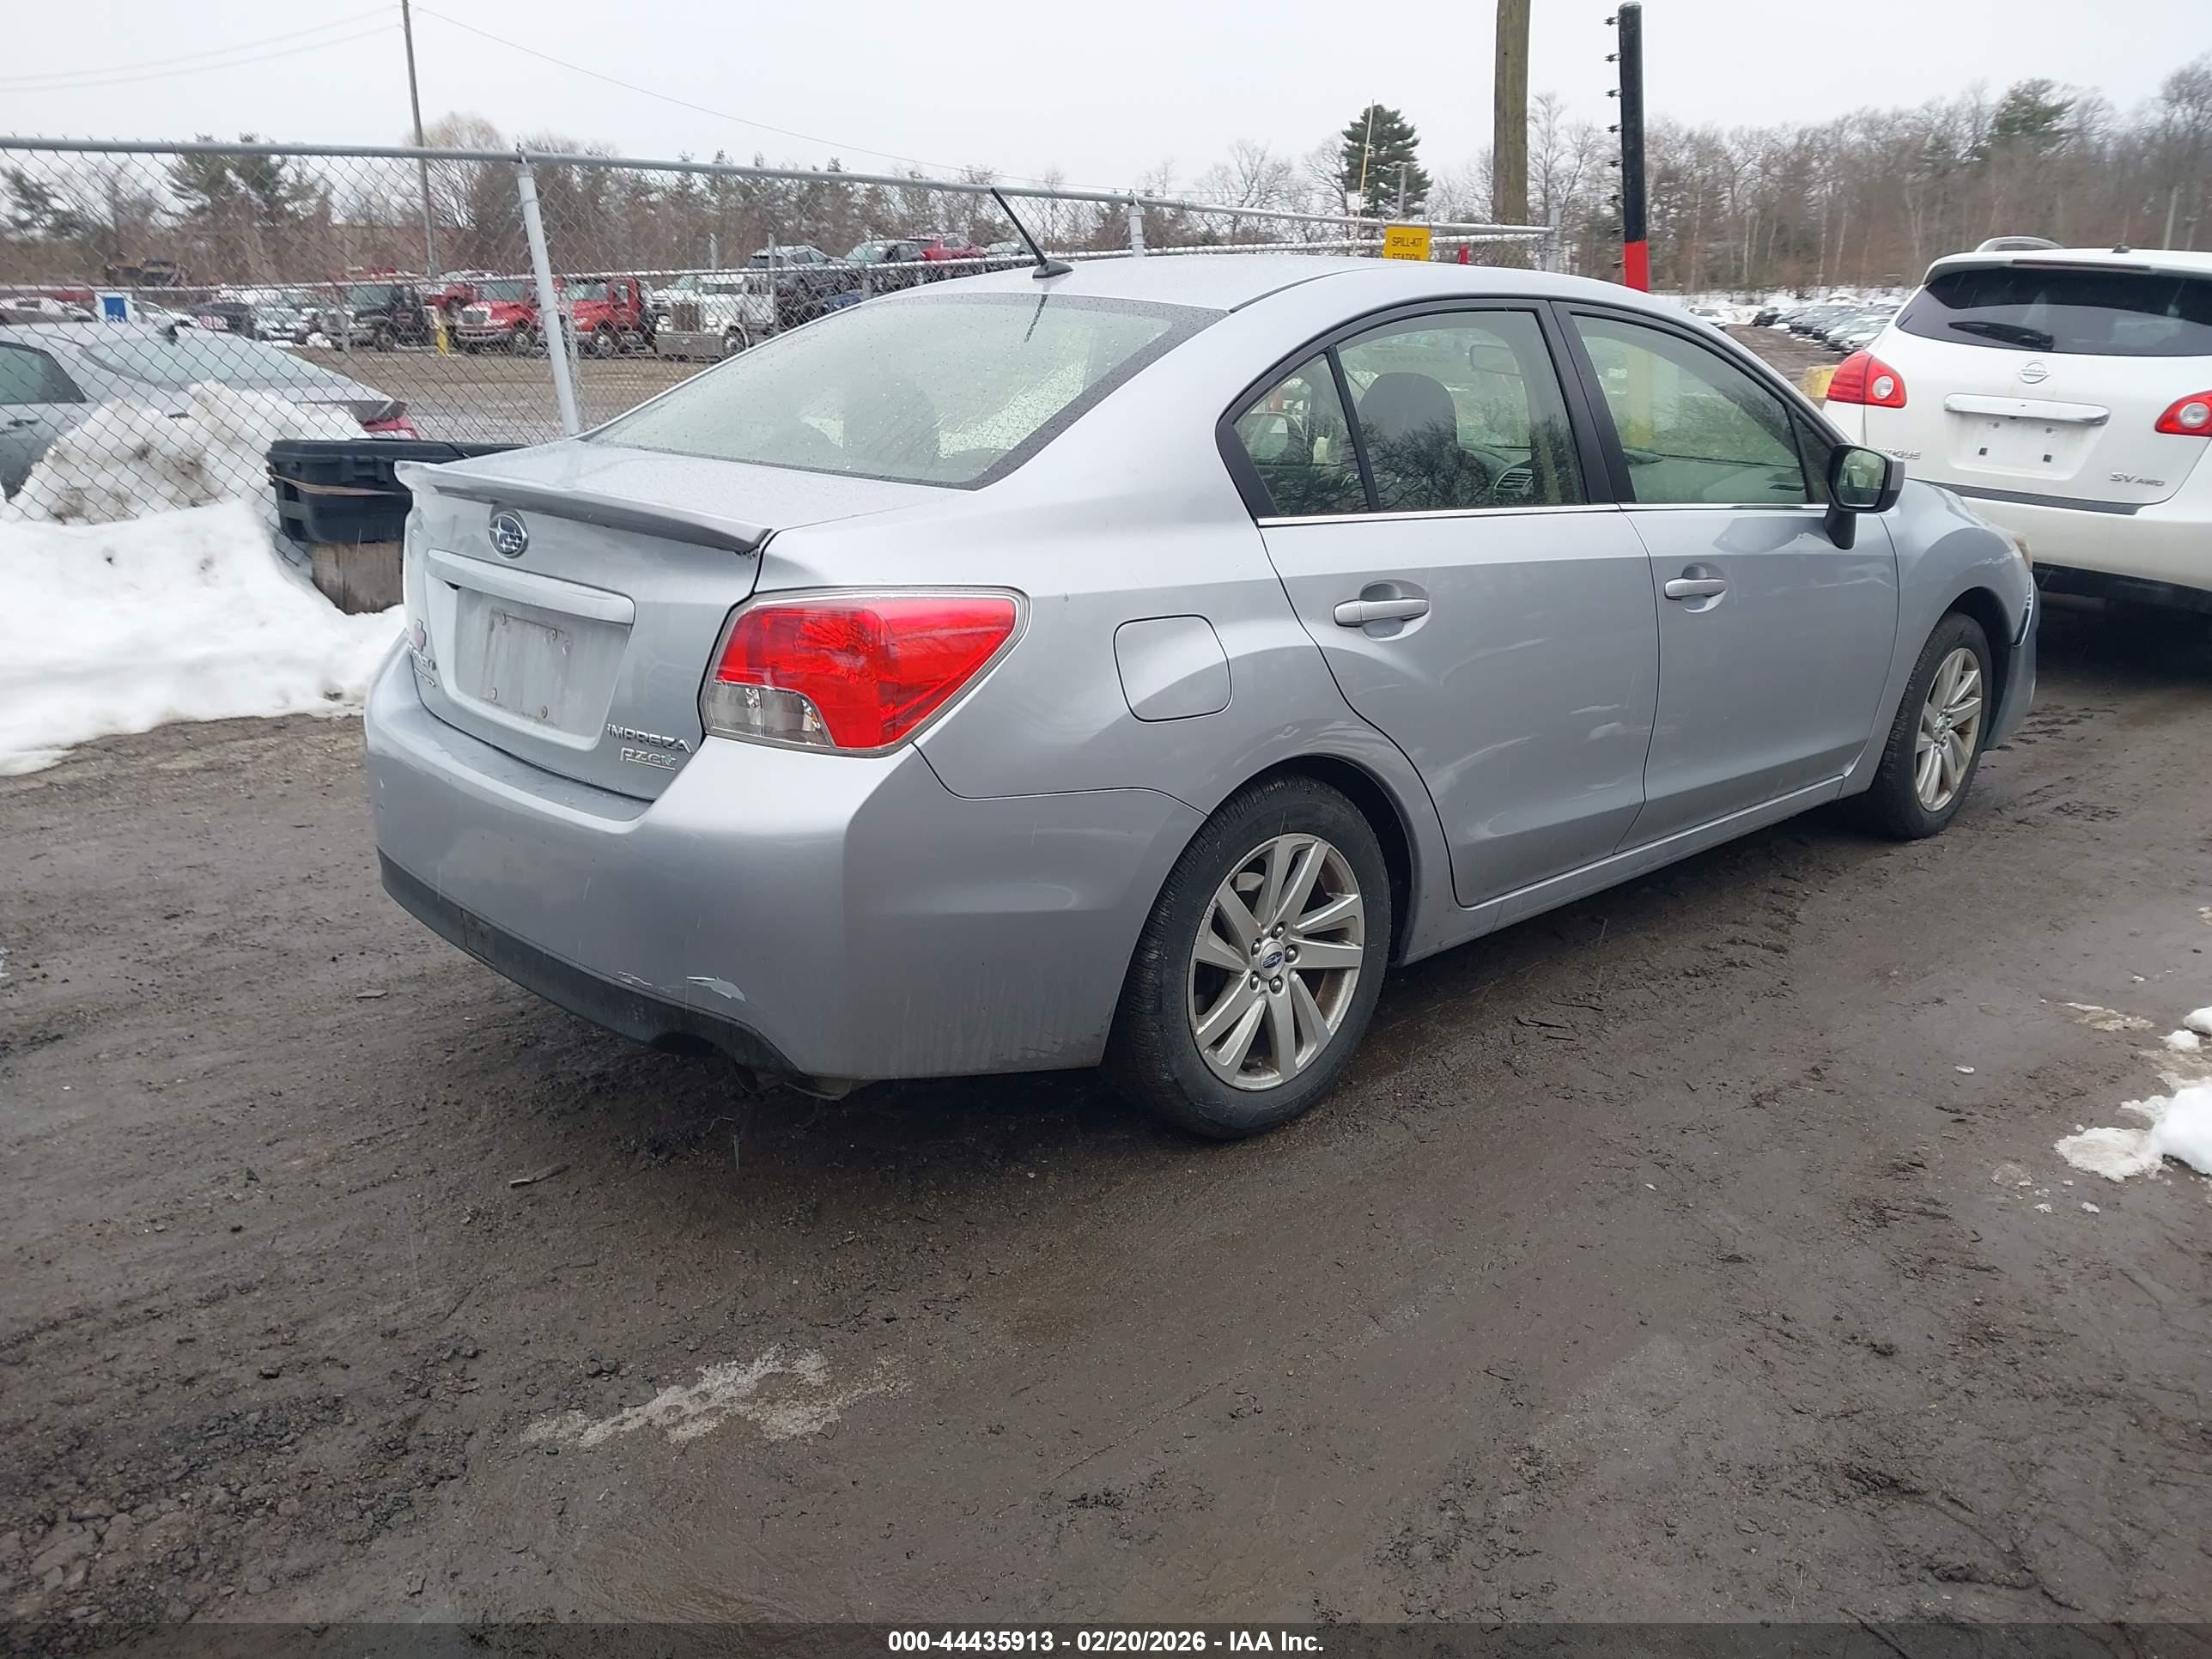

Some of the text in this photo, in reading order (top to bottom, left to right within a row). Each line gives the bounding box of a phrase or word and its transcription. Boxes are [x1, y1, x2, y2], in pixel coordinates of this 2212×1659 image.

[1392, 236, 1423, 248] SPILL-KIT
[2110, 471, 2165, 487] SV AWD
[607, 723, 694, 754] IMPREZA
